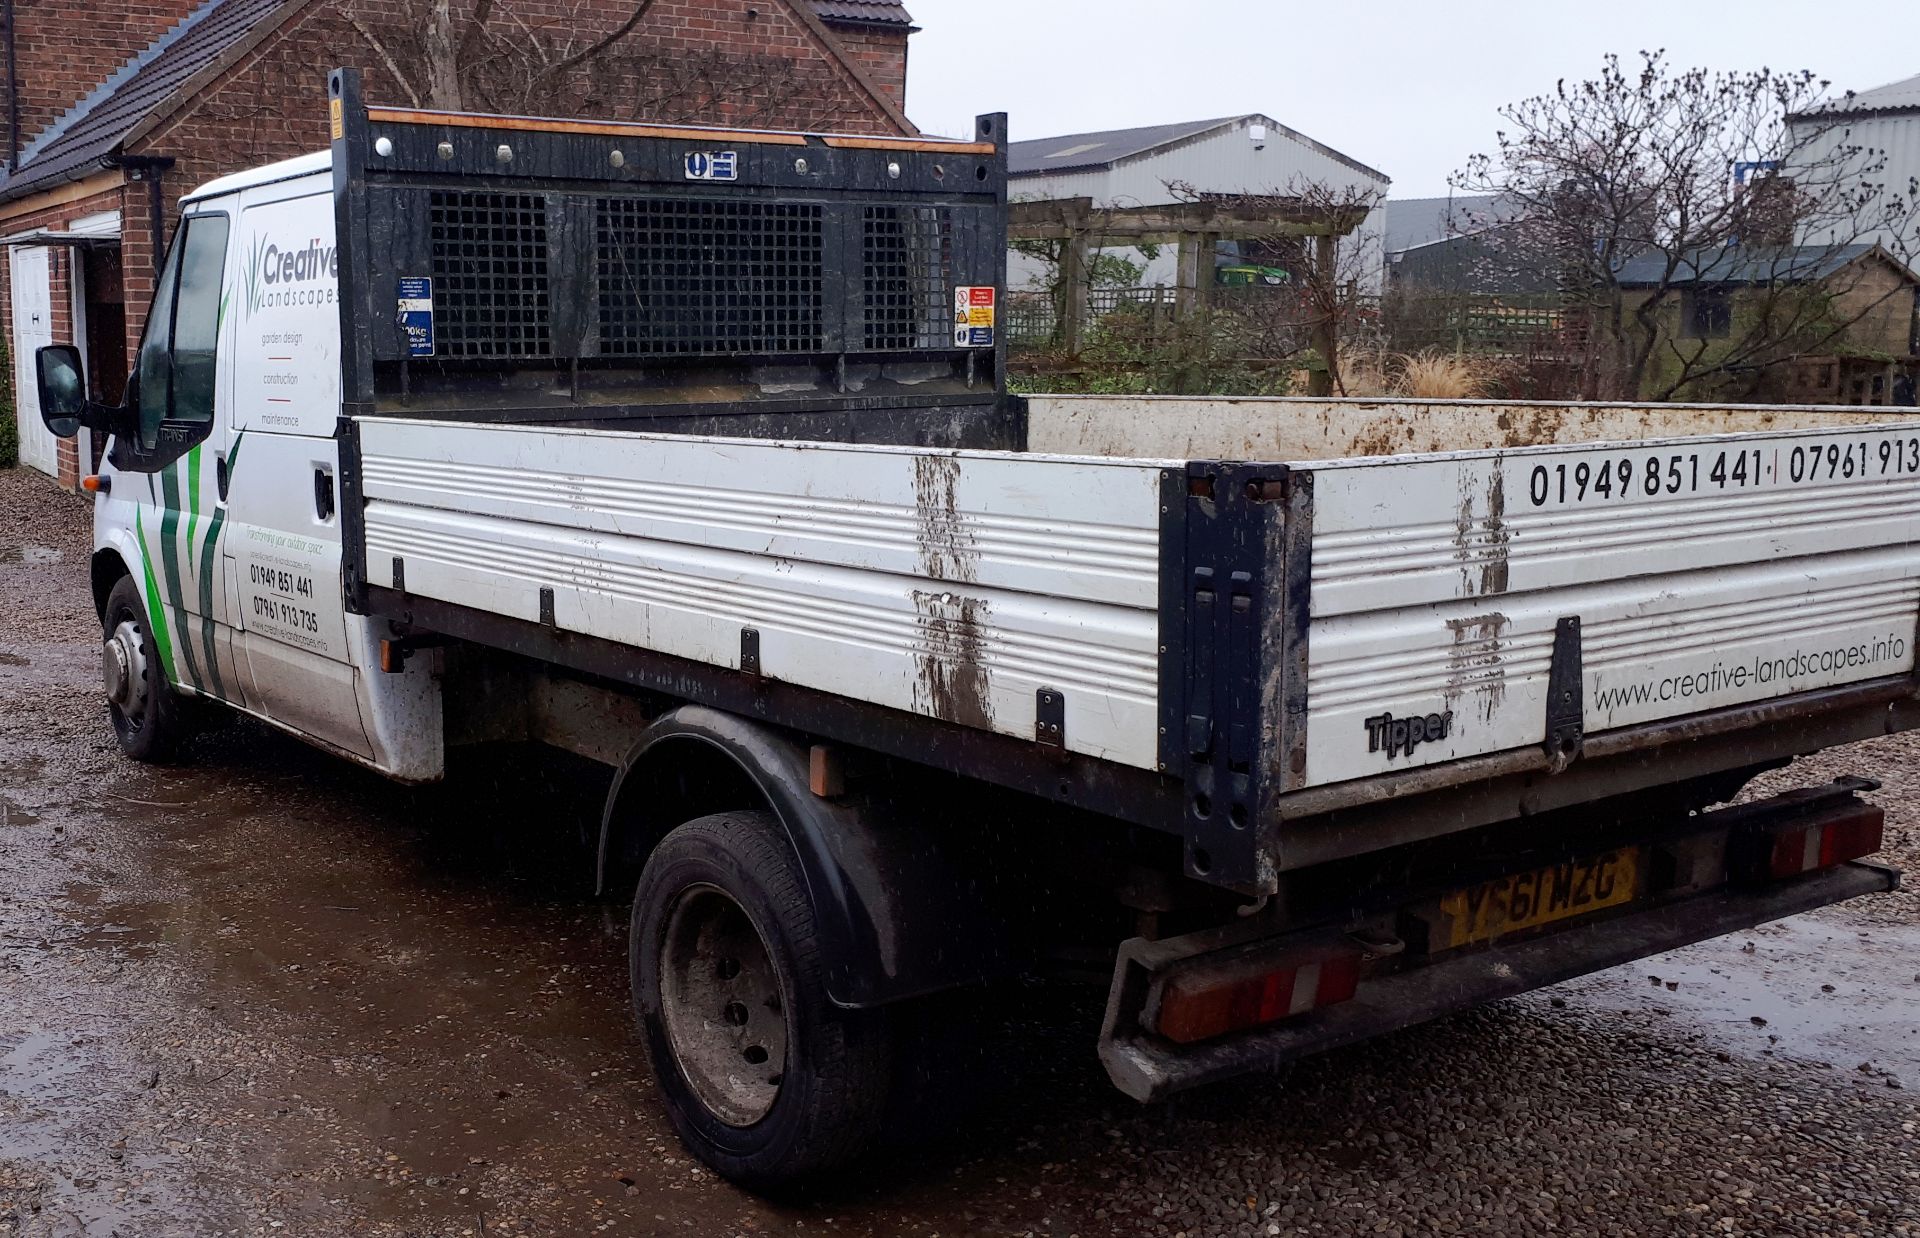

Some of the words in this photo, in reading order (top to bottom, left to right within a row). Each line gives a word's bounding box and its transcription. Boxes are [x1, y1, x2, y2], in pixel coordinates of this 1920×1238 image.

[263, 237, 338, 285] Creative
[261, 332, 281, 347] garden
[283, 331, 303, 346] design
[263, 373, 299, 385] construction
[261, 412, 300, 427] maintenance
[1530, 458, 1633, 507] 01949
[1644, 454, 1699, 496] 851
[1709, 449, 1762, 489] 441
[1789, 442, 1867, 484] 07961
[1877, 437, 1920, 475] 913
[250, 563, 276, 589] 01949
[278, 570, 294, 594] 851
[296, 575, 313, 599] 441
[253, 595, 279, 621] 07961
[281, 603, 299, 627] 913
[299, 609, 318, 633] 735
[1596, 632, 1905, 712] www.creative-landscapes.info
[1364, 711, 1454, 761] Tipper
